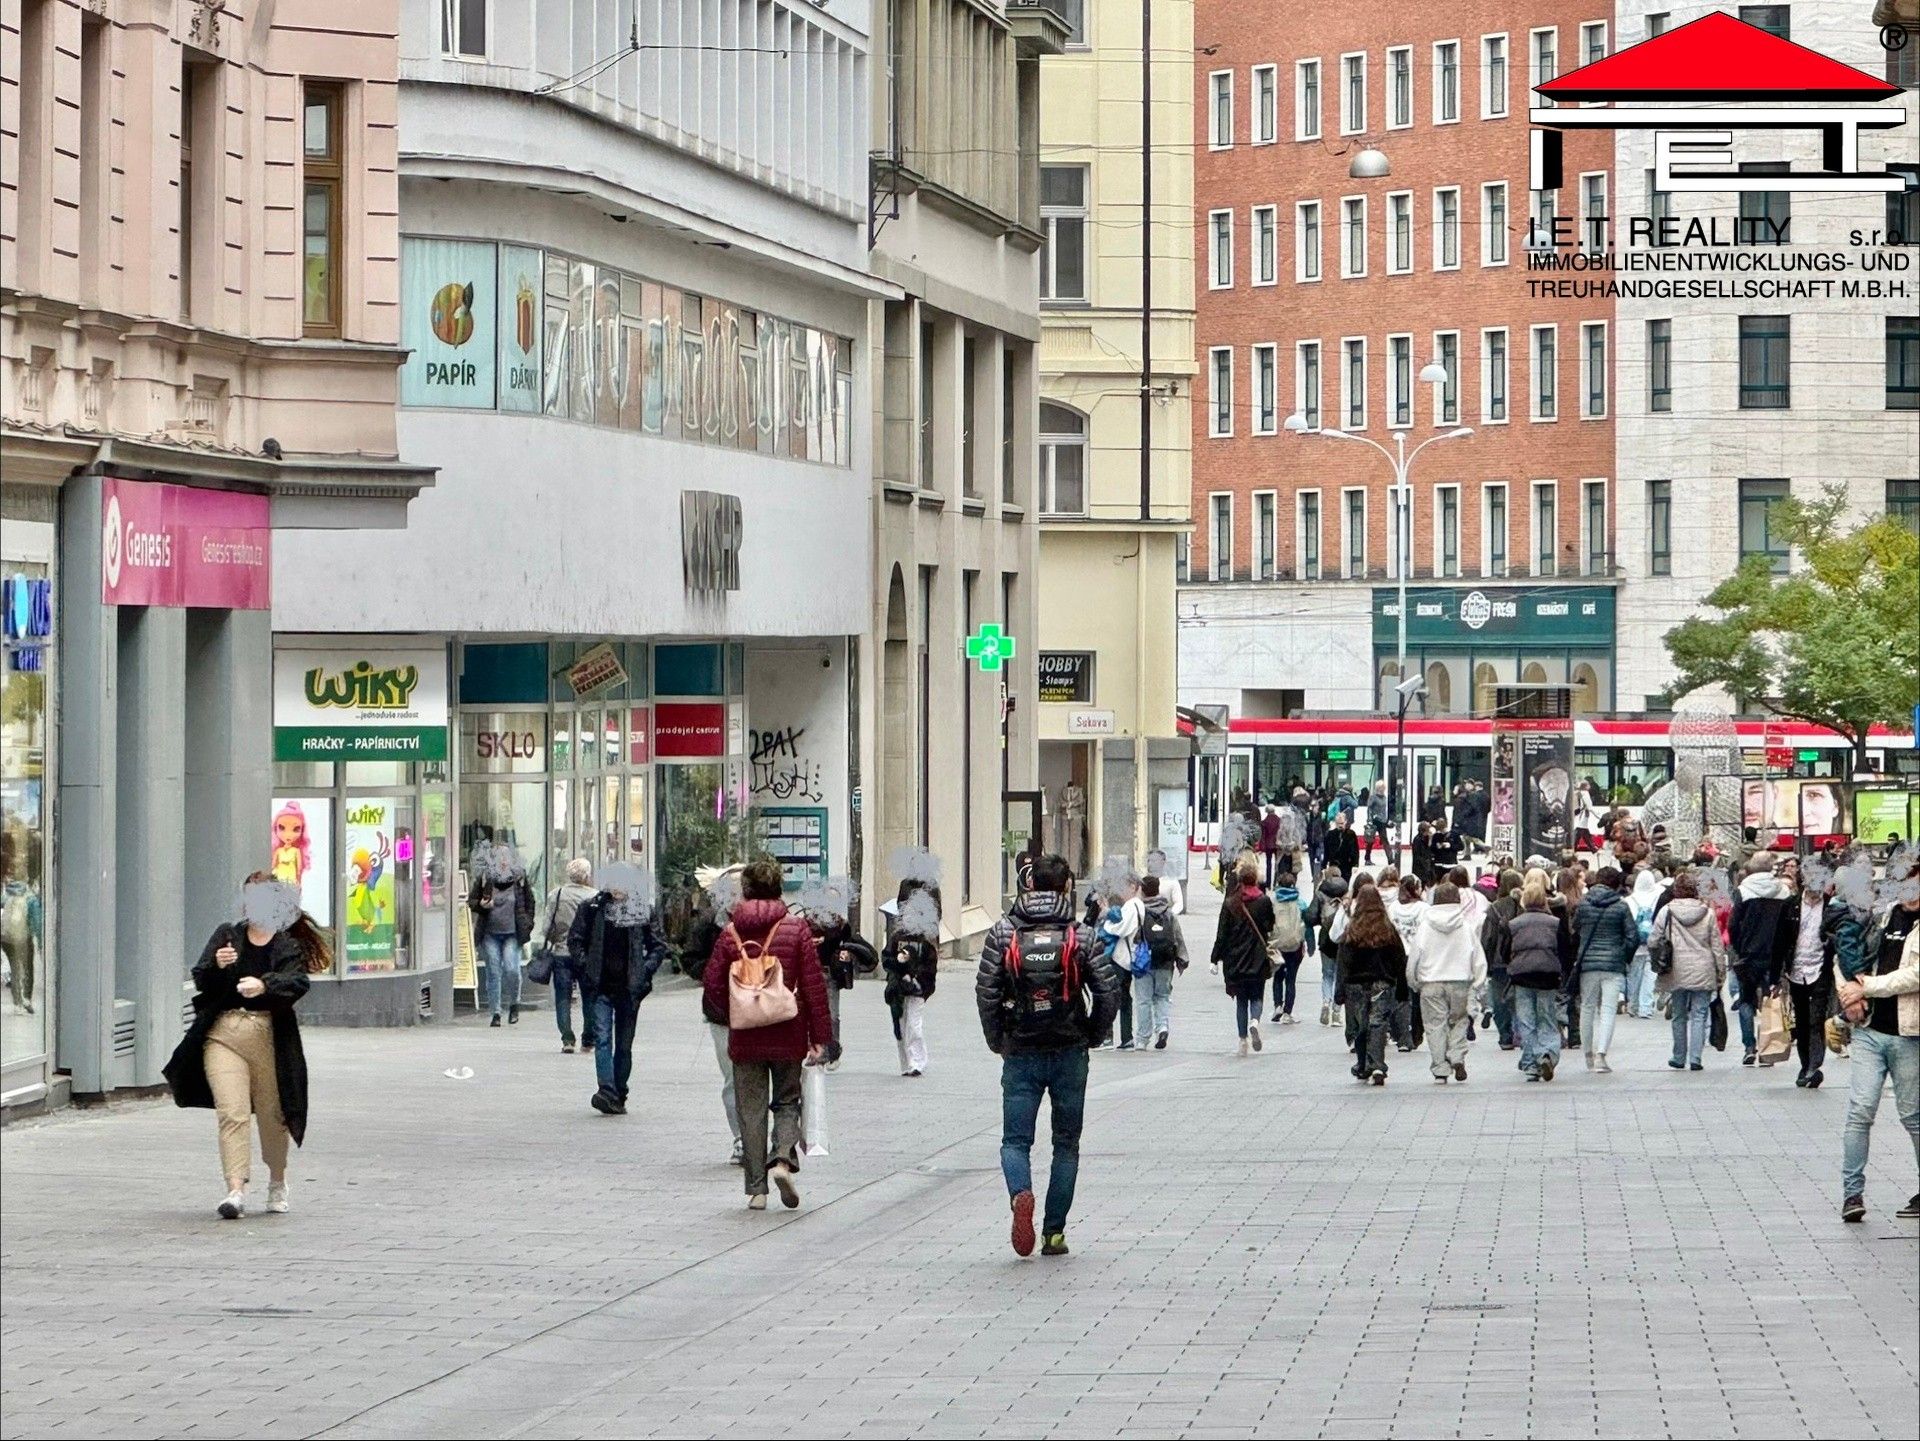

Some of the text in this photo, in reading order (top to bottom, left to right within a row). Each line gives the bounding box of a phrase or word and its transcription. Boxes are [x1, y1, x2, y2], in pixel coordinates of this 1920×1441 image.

[426, 359, 476, 386] PAPÍR
[126, 521, 171, 568] Genesis
[303, 735, 345, 750] HRAČKY
[355, 735, 419, 749] PAPÍRNICTVÍ
[477, 731, 536, 759] SKLO
